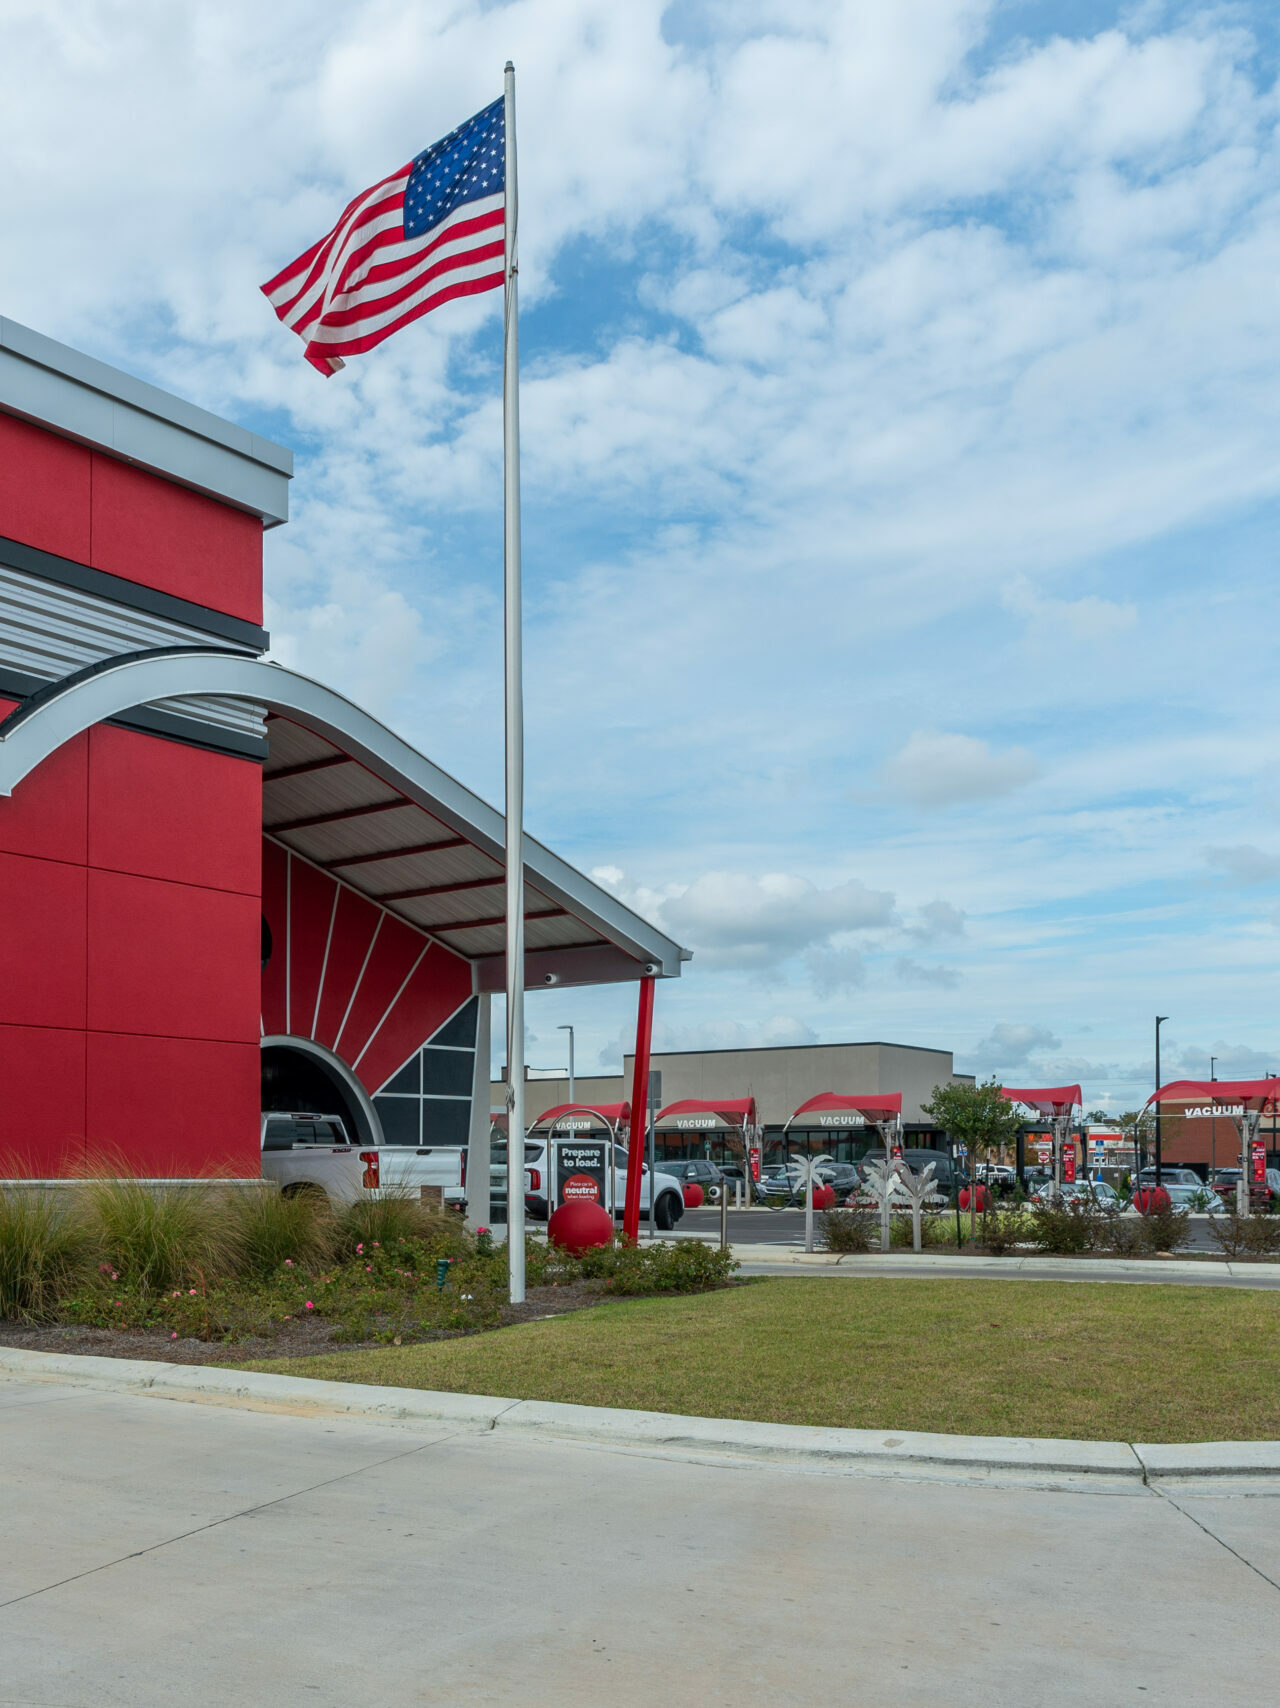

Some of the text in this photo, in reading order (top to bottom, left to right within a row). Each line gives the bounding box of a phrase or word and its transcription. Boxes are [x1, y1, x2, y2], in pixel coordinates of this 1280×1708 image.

[1184, 1105, 1243, 1116] VACUUM
[556, 1121, 591, 1129] VACUUM
[677, 1119, 716, 1128] VACUUM
[820, 1116, 865, 1125] VACUUM
[562, 1148, 600, 1158] Prepare
[563, 1158, 600, 1167] to load.
[565, 1186, 598, 1194] neutral
